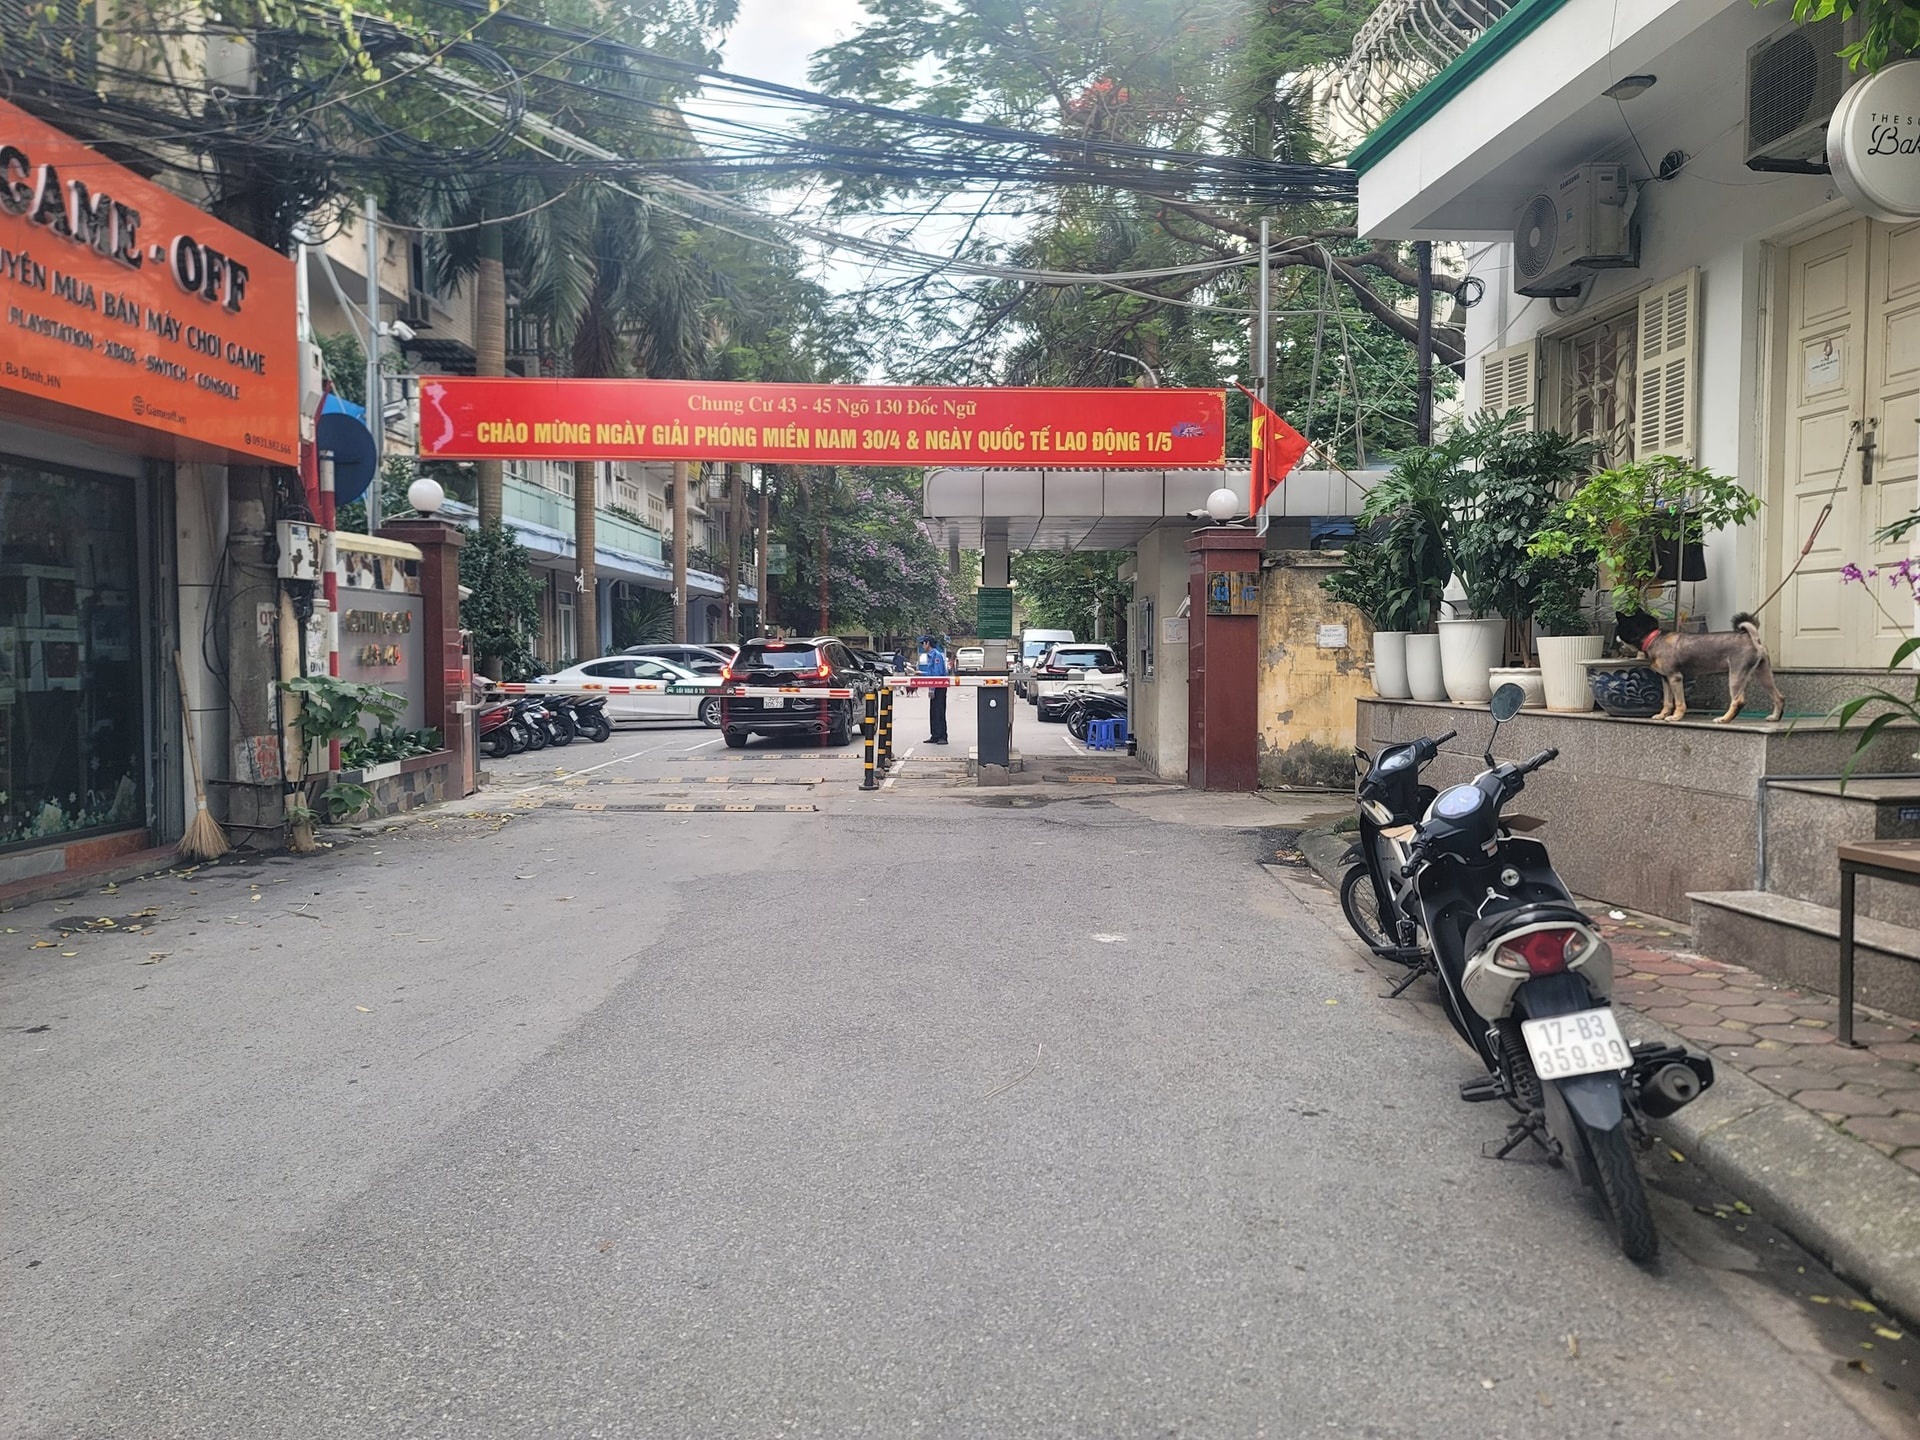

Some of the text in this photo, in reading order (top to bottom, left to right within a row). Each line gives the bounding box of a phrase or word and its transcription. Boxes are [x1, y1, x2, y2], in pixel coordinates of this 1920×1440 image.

[1871, 112, 1920, 126] THE S
[0, 145, 142, 270] GAME
[170, 234, 249, 315] OFF
[51, 270, 97, 312] MUA
[103, 290, 140, 328] BÁN
[145, 308, 182, 343] MÁY
[225, 342, 266, 376] GAME
[6, 361, 19, 377] Ba
[8, 306, 94, 351] PLAYSTATION
[102, 339, 137, 365] XBOX
[145, 353, 187, 383] SWITCH
[193, 372, 240, 401] CONSOLE
[688, 394, 744, 416] Chung
[748, 396, 774, 412] Cư
[777, 397, 797, 414] 43
[812, 398, 832, 414] 45
[836, 398, 869, 418] Ngõ
[875, 399, 902, 415] 130
[907, 396, 938, 416] Đốc
[943, 399, 977, 420] Ngữ
[477, 419, 1172, 456] CHÀO MỪNG NGÀY GIẢI PHÓNG MIỀN NAM 30/4 & NGÀY QUỐC TẾ LAO ĐỘNG 1/5
[1538, 1014, 1607, 1046] 17-B3
[1539, 1040, 1624, 1074] 359.99
